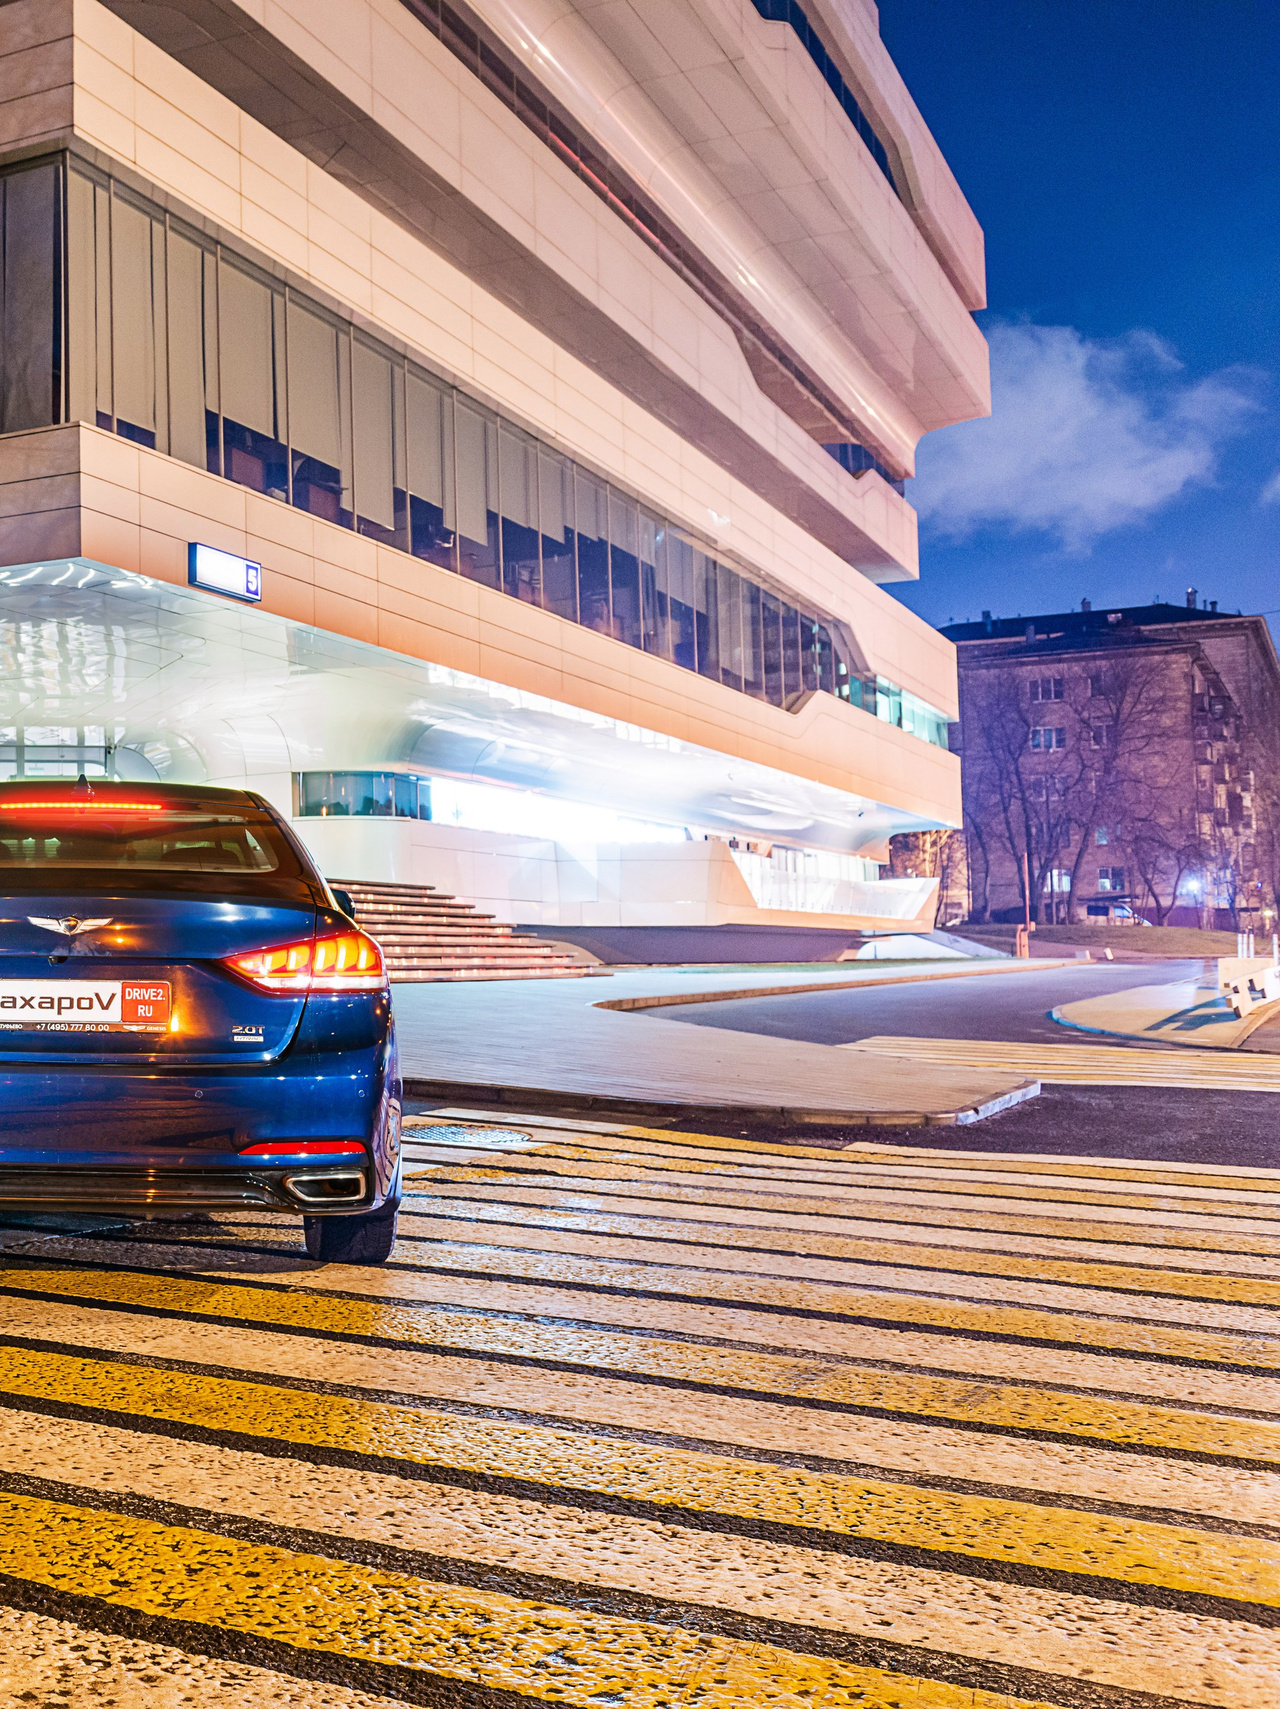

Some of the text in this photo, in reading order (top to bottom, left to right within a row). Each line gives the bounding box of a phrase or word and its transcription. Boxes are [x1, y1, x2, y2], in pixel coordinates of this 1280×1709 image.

[247, 568, 257, 591] 5
[125, 988, 166, 1000] DRIVE2.
[137, 1004, 153, 1017] RU
[36, 1023, 45, 1031] +7
[47, 1022, 68, 1031] (495)
[231, 1025, 265, 1034] 2.0T
